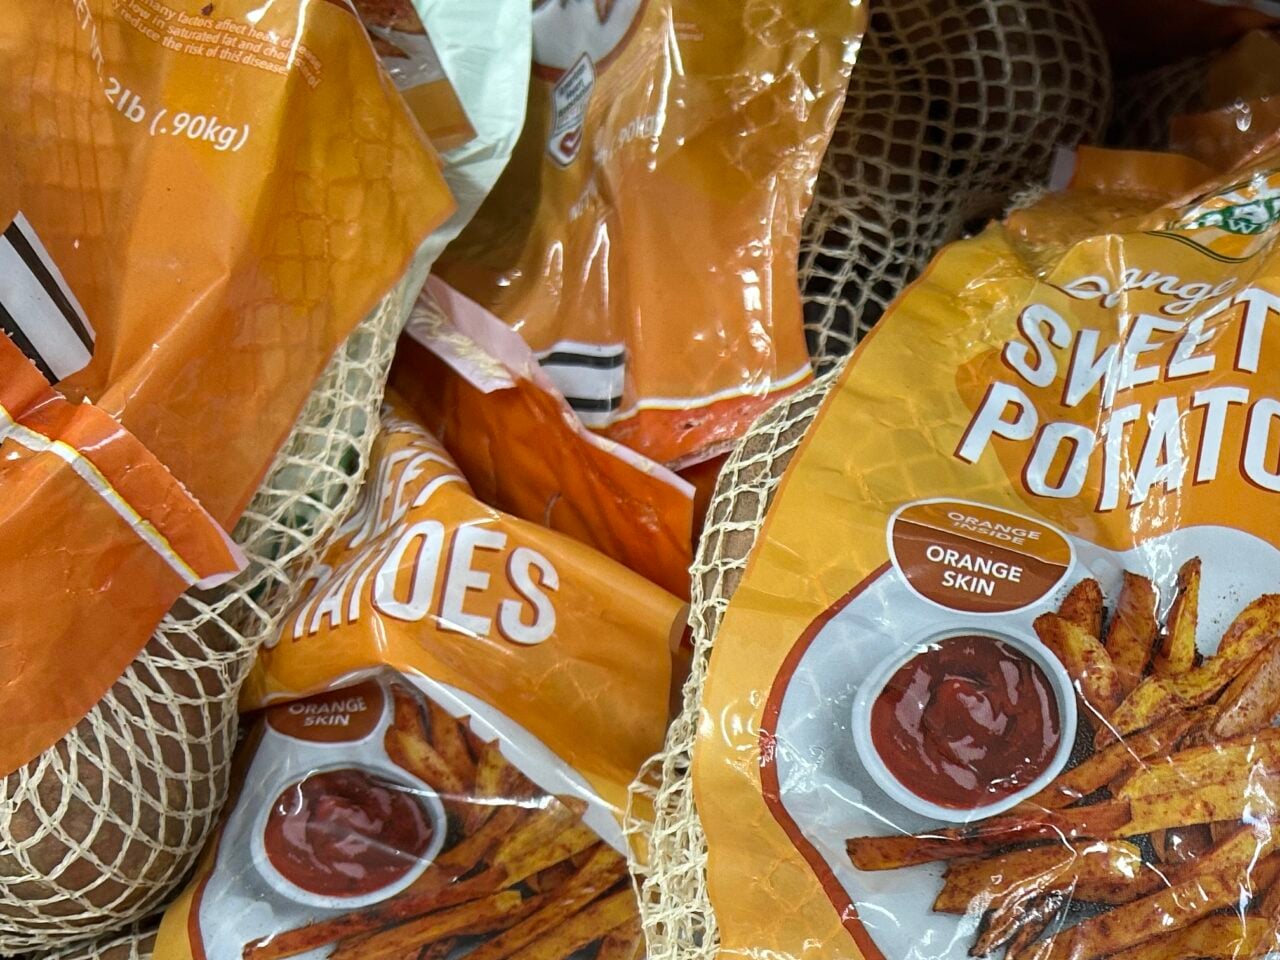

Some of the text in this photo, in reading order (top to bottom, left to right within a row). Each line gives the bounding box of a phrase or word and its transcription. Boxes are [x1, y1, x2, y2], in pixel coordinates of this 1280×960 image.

[120, 8, 161, 42] reduce
[162, 36, 183, 51] the
[184, 42, 206, 56] risk
[206, 45, 219, 58] of
[219, 47, 243, 63] this
[167, 25, 220, 44] saturated
[221, 35, 239, 47] fat
[238, 40, 263, 54] and
[214, 19, 247, 35] affect
[104, 76, 146, 124] 2lb
[150, 109, 249, 152] (.90kg)
[946, 512, 1042, 541] ORANGE
[953, 522, 1026, 546] INSIDE
[925, 545, 1023, 583] ORANGE
[941, 570, 995, 597] SKIN
[288, 697, 367, 716] ORANGE
[303, 713, 350, 727] SKIN
